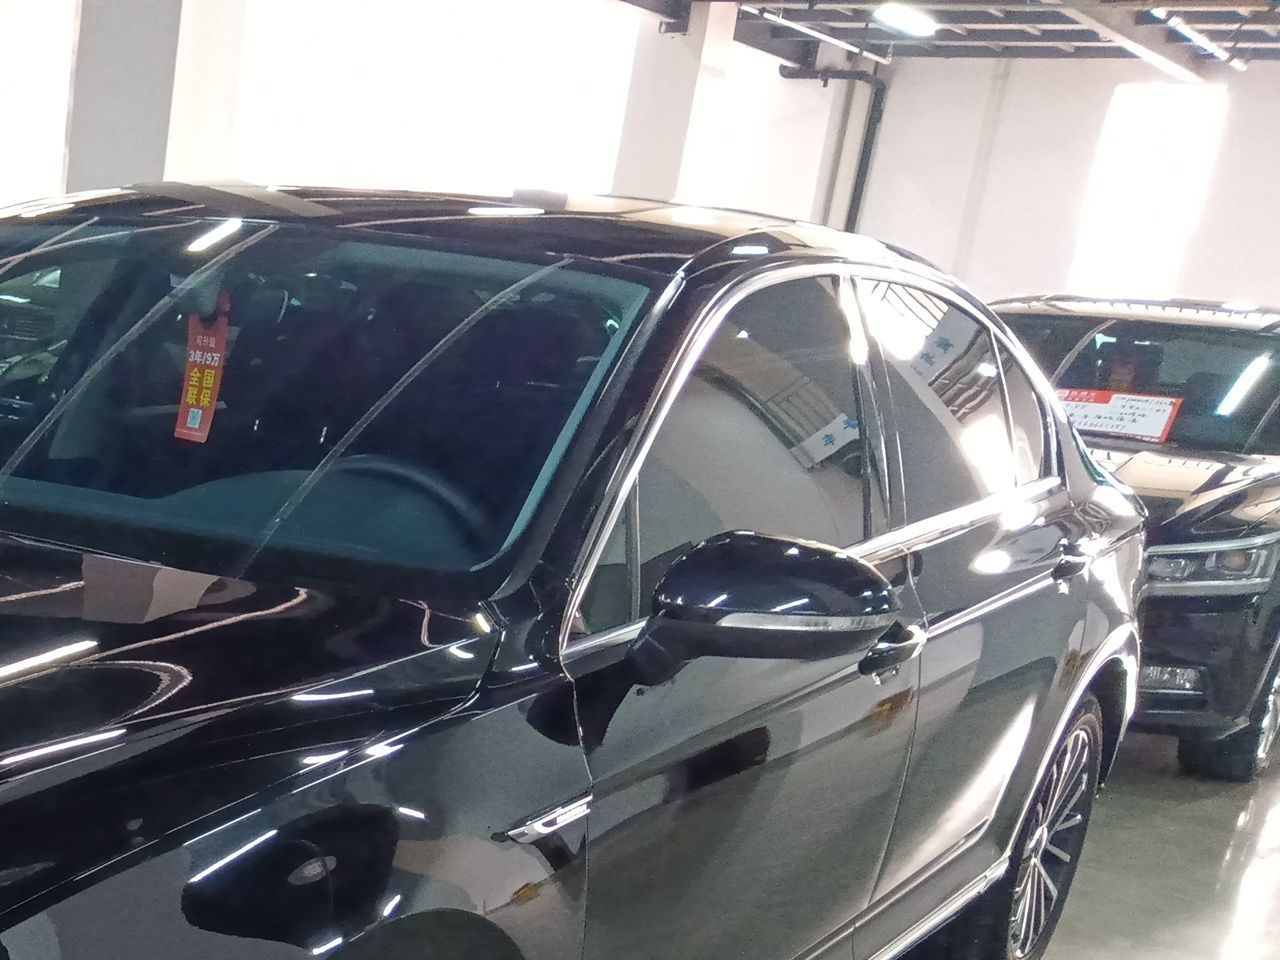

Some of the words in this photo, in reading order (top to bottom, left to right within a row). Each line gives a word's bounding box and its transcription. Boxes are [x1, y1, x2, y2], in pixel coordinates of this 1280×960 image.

[189, 350, 220, 366] 3年/9万
[190, 367, 215, 388] 全国
[186, 386, 211, 407] 联保
